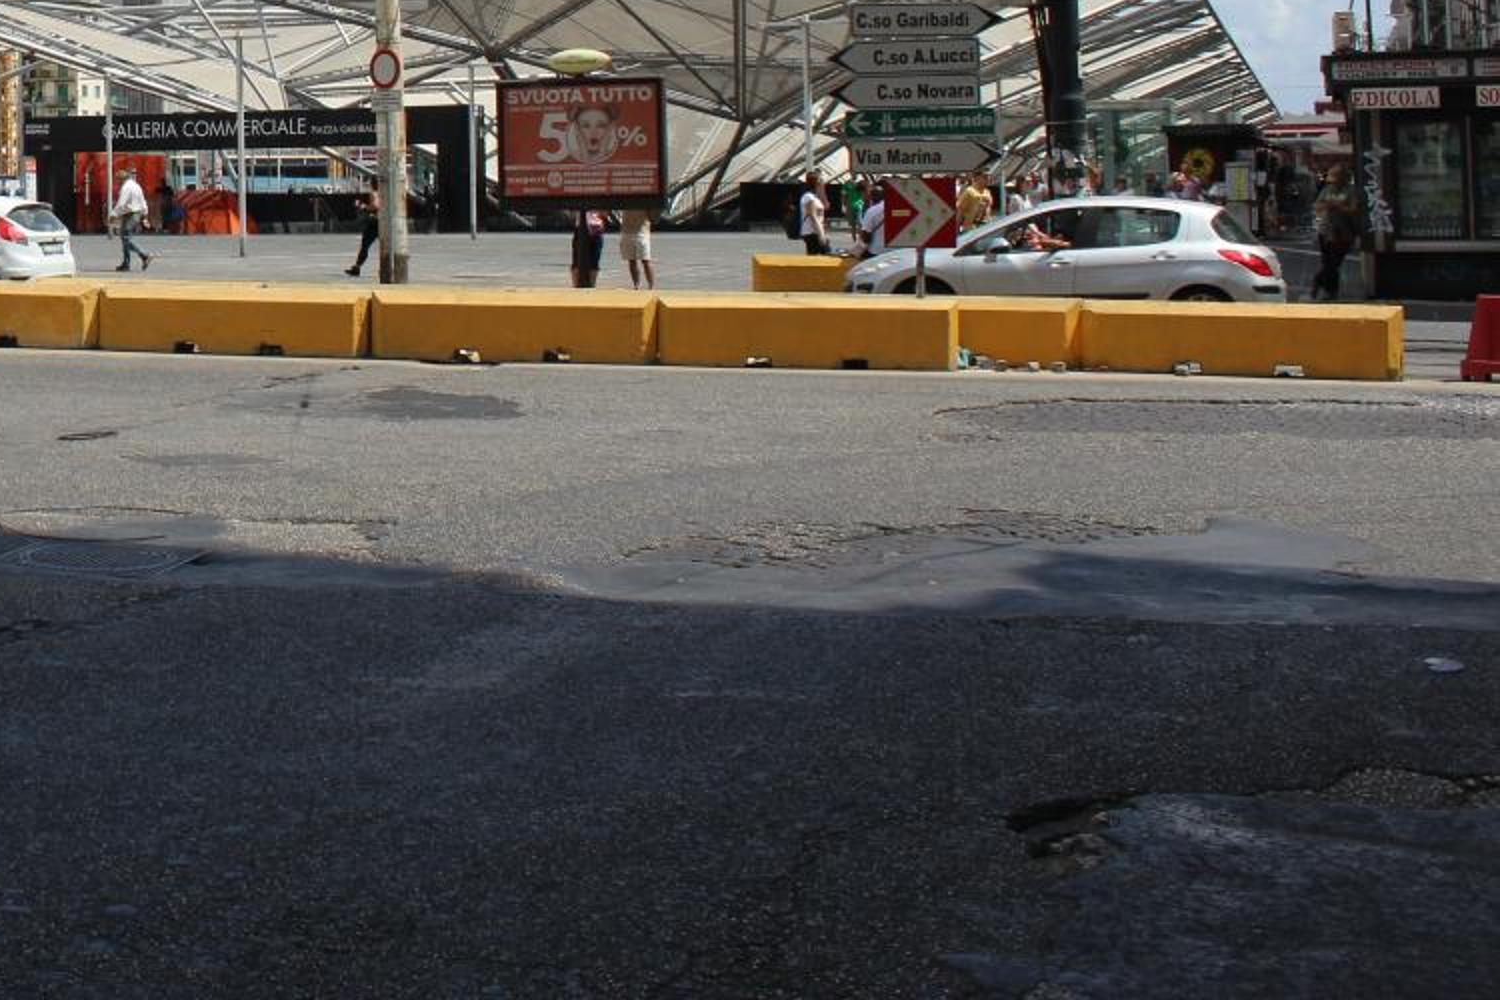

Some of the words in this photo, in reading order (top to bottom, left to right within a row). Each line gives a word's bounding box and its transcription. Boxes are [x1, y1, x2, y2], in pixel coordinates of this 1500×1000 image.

[855, 13, 892, 29] C.so
[896, 12, 970, 29] Garibaldi
[873, 49, 909, 65] C.so
[913, 47, 975, 65] A.Lucci
[508, 87, 583, 105] SVUOTA
[587, 86, 652, 103] TUTTO
[876, 84, 912, 100] C.so
[916, 83, 975, 99] Novara
[1352, 89, 1436, 107] EDICOLA
[182, 117, 307, 138] COMMERCIALE
[900, 113, 994, 129] autostrade
[856, 148, 882, 165] Via
[887, 149, 942, 165] Marina
